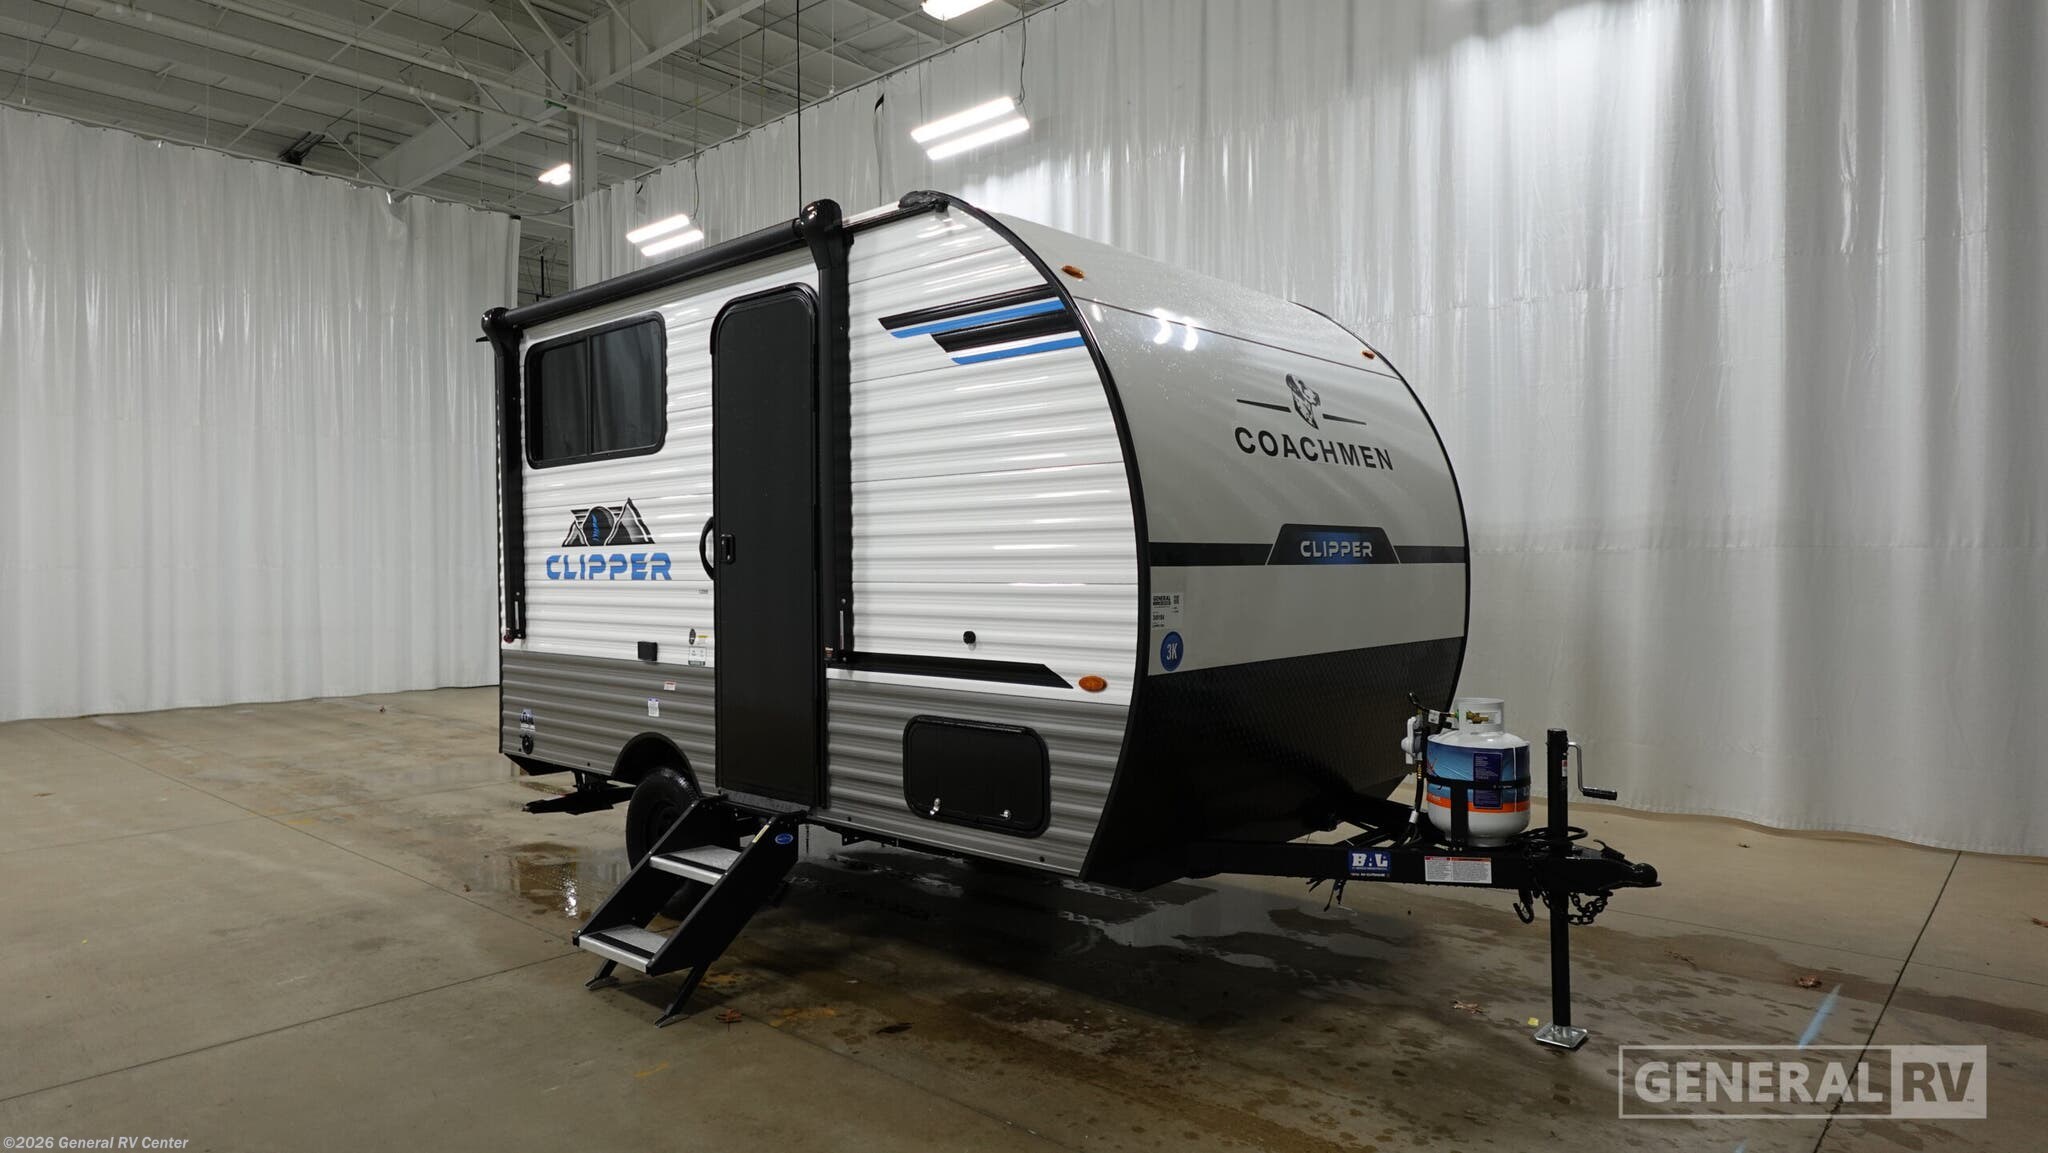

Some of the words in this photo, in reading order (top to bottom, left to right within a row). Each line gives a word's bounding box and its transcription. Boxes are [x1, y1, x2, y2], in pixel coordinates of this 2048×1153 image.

[1235, 427, 1393, 470] COACHMEN
[1300, 541, 1373, 558] CLIPPER
[546, 552, 672, 581] CLIPPER
[1166, 643, 1178, 661] 3K
